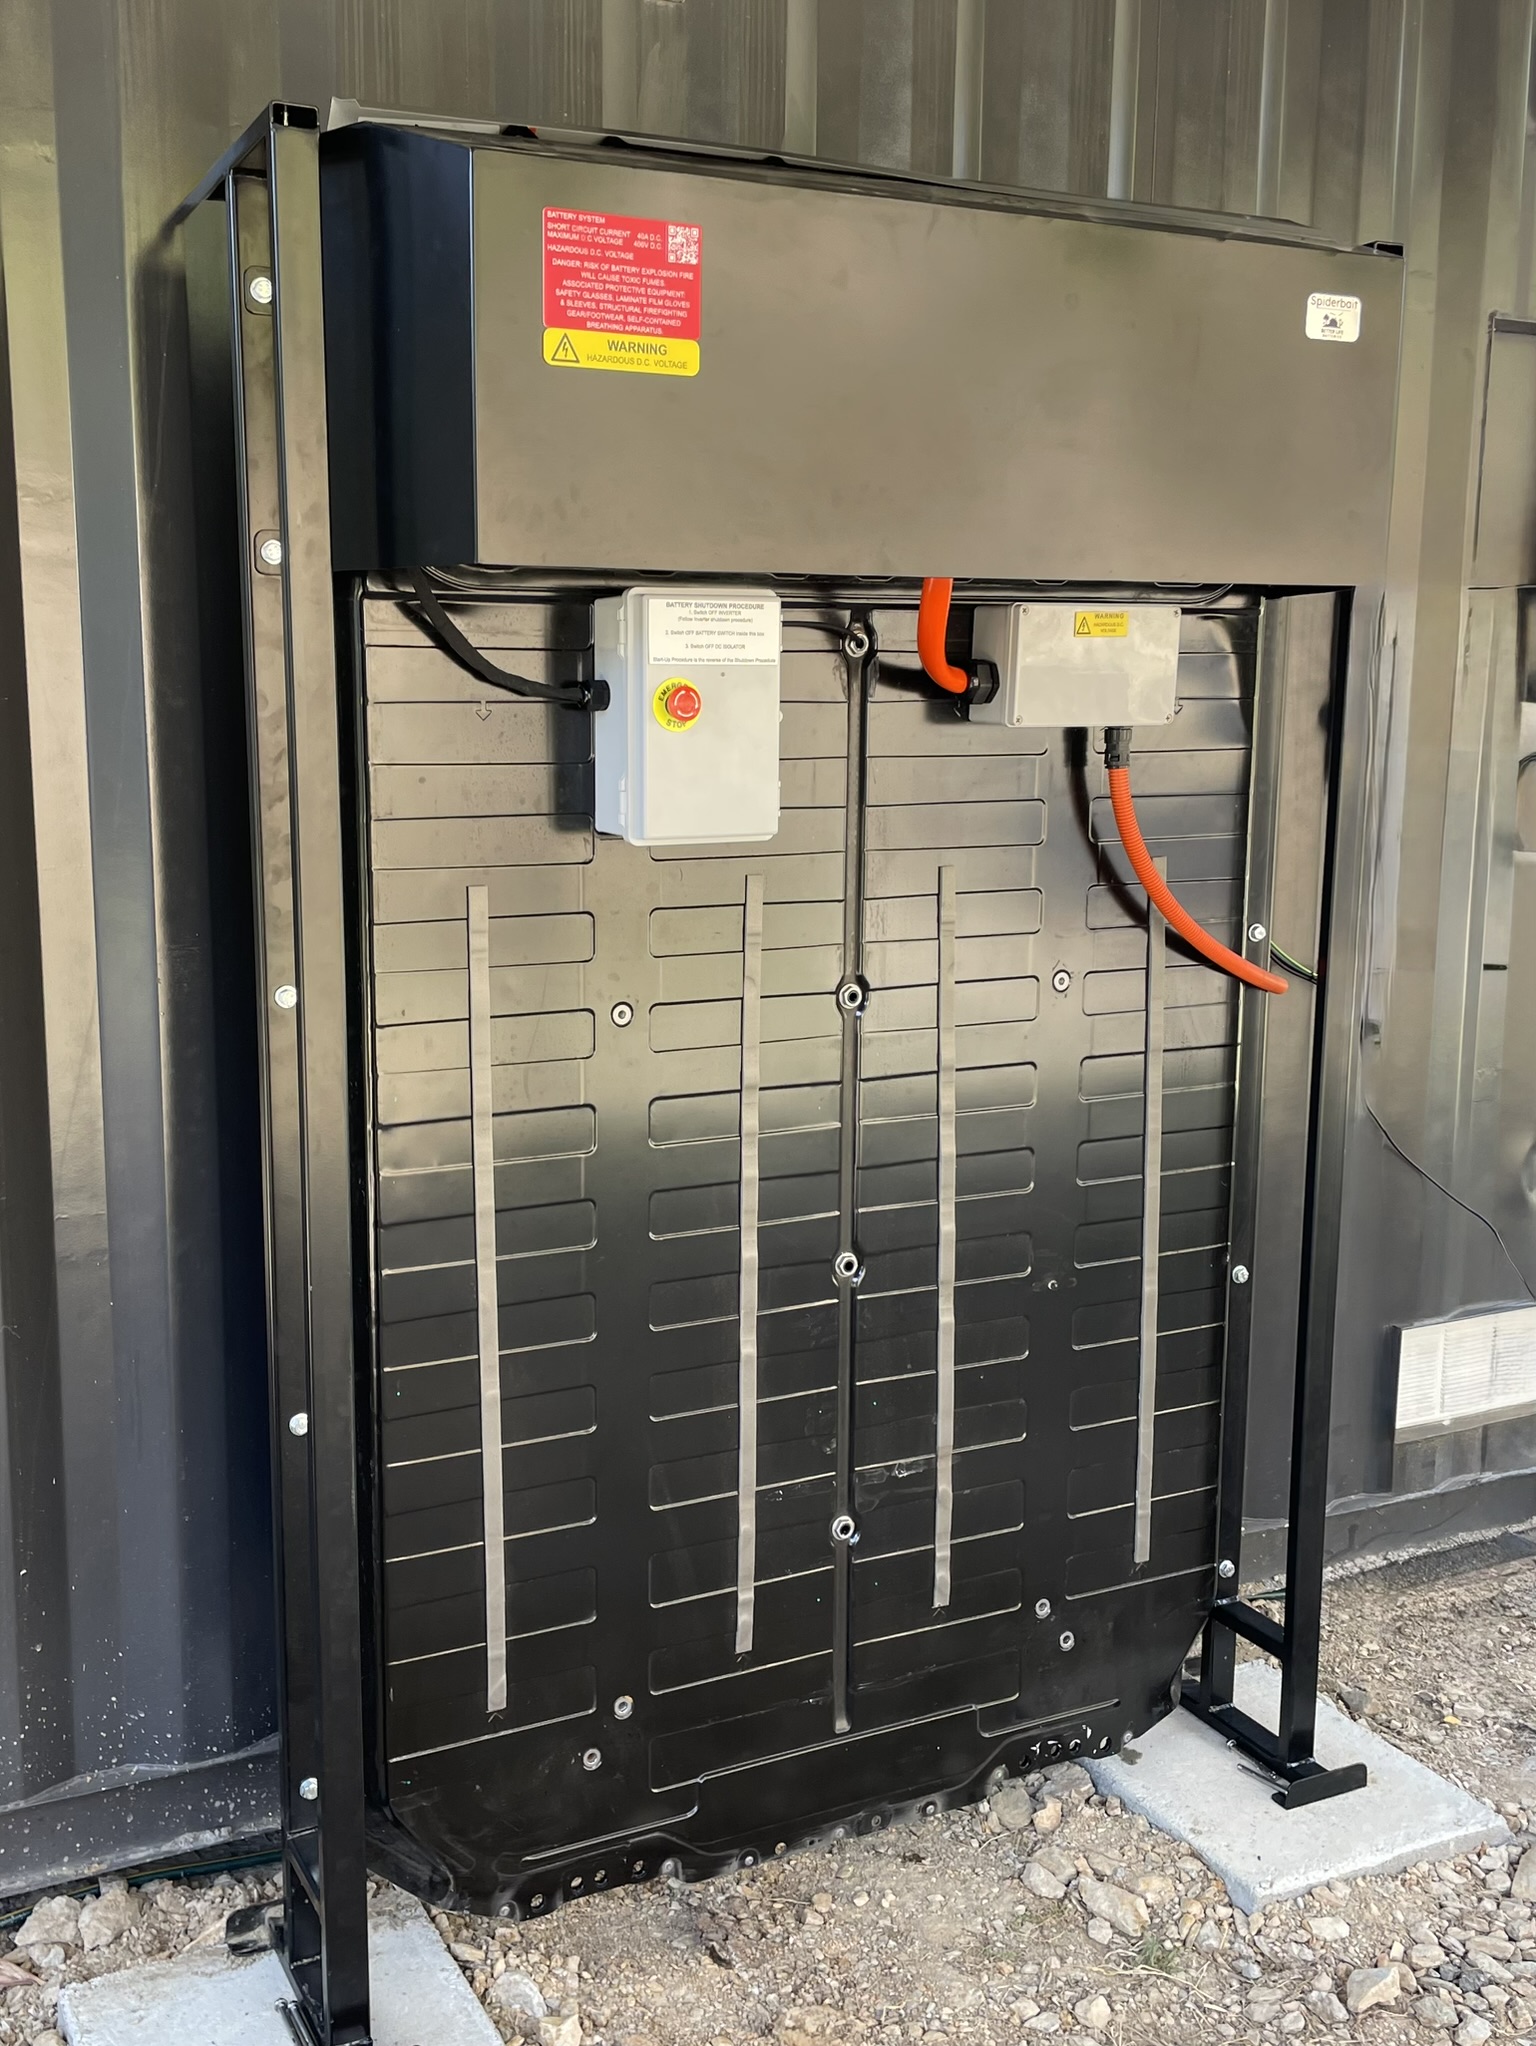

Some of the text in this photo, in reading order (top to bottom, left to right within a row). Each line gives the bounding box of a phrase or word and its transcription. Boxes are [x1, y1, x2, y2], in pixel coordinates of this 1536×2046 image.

[547, 210, 605, 224] BATTERY SYSTEM
[547, 222, 570, 231] SHORT
[571, 225, 598, 235] CIRCUIT
[599, 227, 631, 238] CURRENT
[547, 231, 580, 241] MAXIMUM
[593, 236, 623, 246] VOLTAGE
[547, 244, 589, 256] HAZARDOUS
[604, 250, 634, 261] VOLTAGE
[552, 258, 694, 280] DANGER: RISK OF BATTERY EXPLOSION FIRE
[580, 271, 597, 280] WILL
[597, 273, 620, 283] CAUSE
[621, 275, 641, 285] TOXIC
[562, 279, 604, 291] ASSOCIATED
[605, 283, 646, 295] PROTECTIVE
[555, 288, 581, 298] SAFETY
[615, 294, 648, 305] LAMINATE
[648, 297, 664, 306] FILM
[664, 299, 690, 309] GLOVES
[1310, 295, 1358, 310] Spiderbait
[599, 302, 642, 314] STRUCTURAL
[643, 306, 688, 318] FIREFIGHTING
[586, 320, 624, 332] BREATHING
[627, 315, 682, 327] SELF-CONTAINED
[607, 339, 668, 356] WARNING
[586, 353, 635, 366] HAZARDOUS
[653, 360, 688, 370] VOLTAGE
[665, 601, 765, 611] BATTERY SHUTDOWN PROCEDURE
[1094, 612, 1125, 620] WARNING
